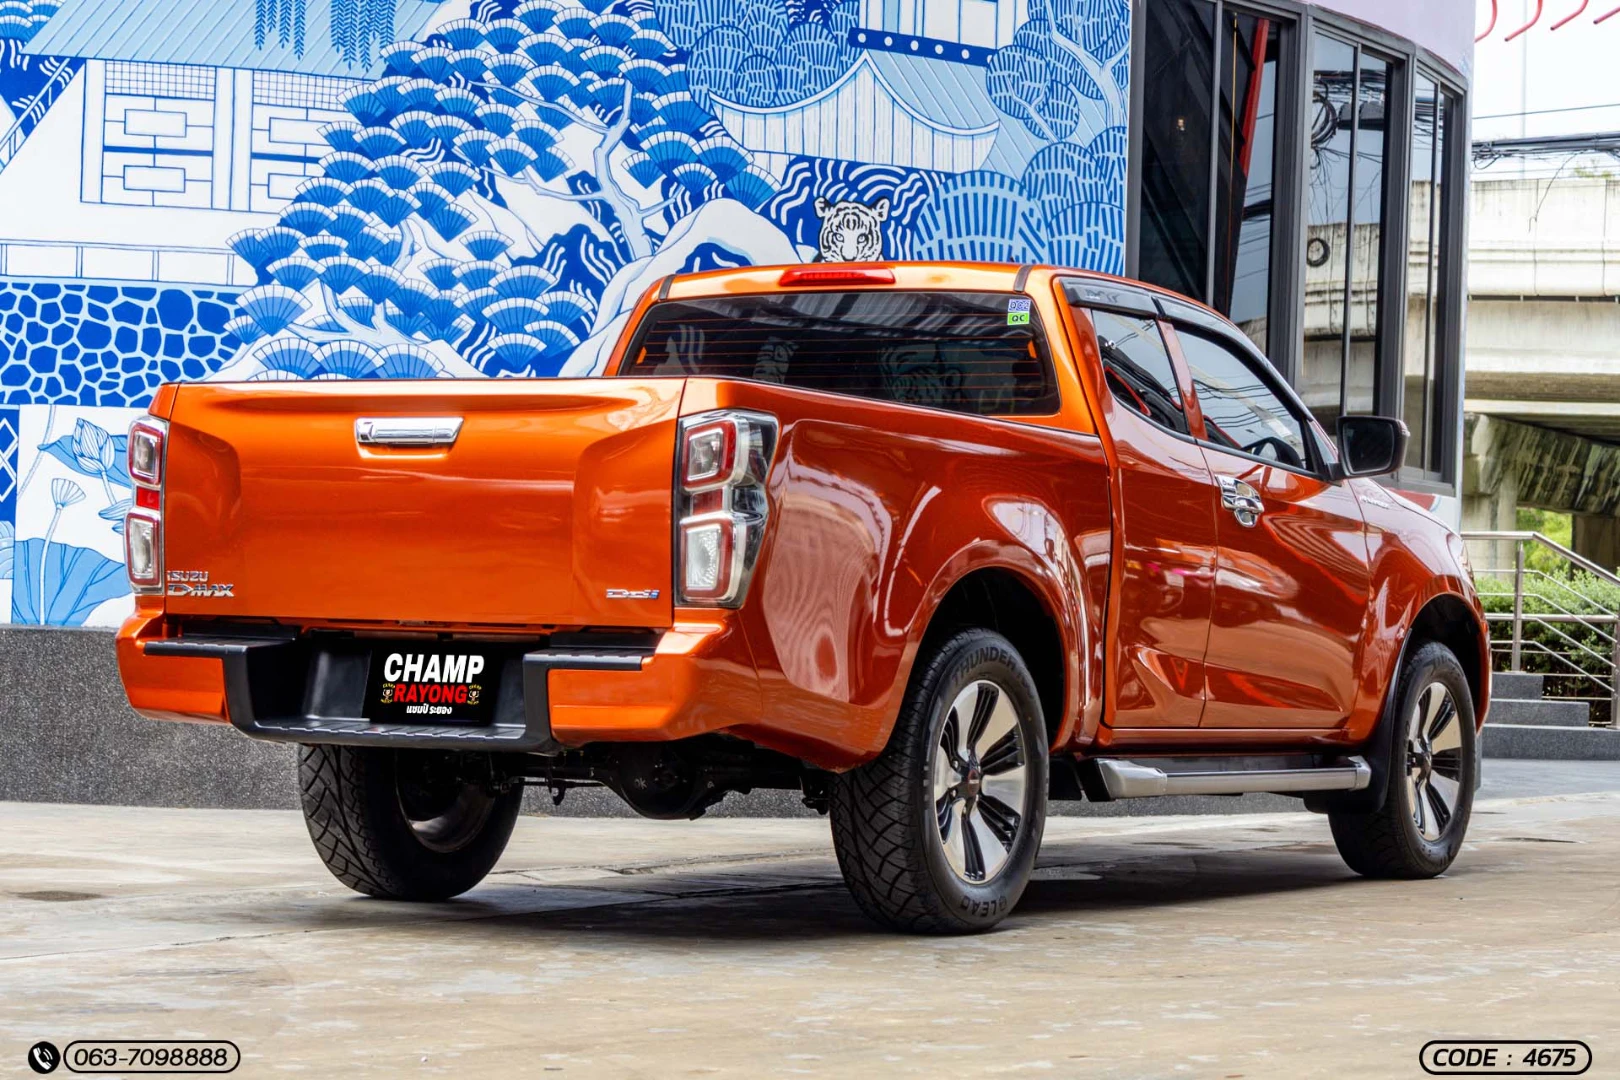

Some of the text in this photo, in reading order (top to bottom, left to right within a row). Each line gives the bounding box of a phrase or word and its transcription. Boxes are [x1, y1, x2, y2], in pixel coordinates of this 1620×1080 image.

[1011, 314, 1025, 322] QC
[166, 570, 208, 582] ISUZU
[384, 653, 484, 683] CHAMP
[394, 684, 468, 703] RAYONG
